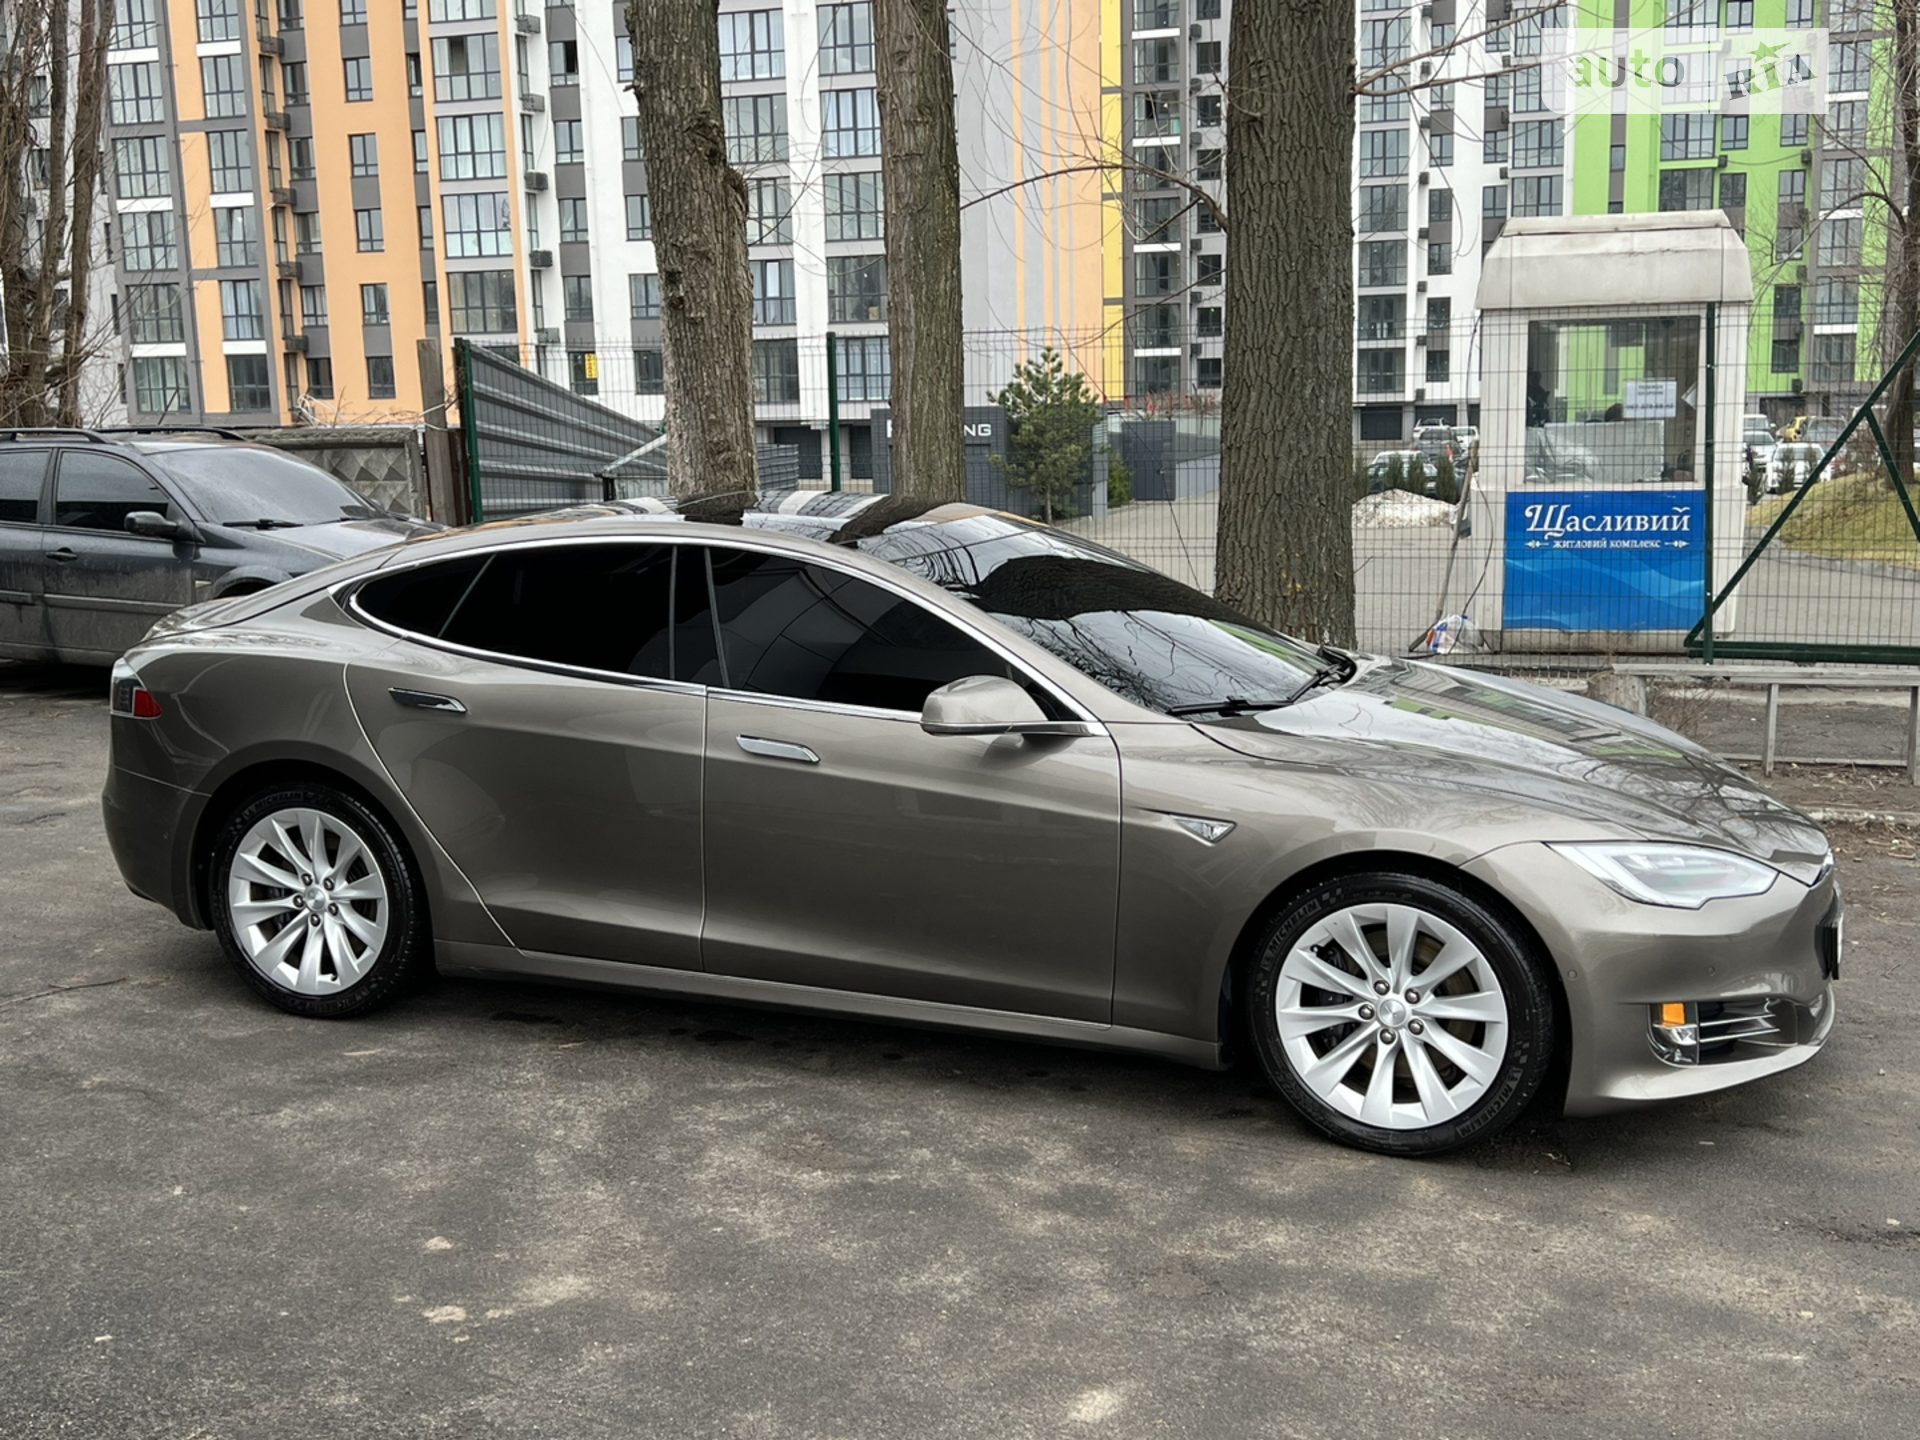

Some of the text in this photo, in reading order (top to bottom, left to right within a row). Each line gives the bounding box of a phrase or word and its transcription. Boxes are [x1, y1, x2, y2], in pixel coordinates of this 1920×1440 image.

[1524, 504, 1691, 540] Щасливий
[1552, 538, 1661, 549] житловий комплекс
[254, 791, 302, 809] MICHELIN
[1268, 900, 1317, 954] MICHELIN
[1460, 1083, 1513, 1137] MICHELIN
